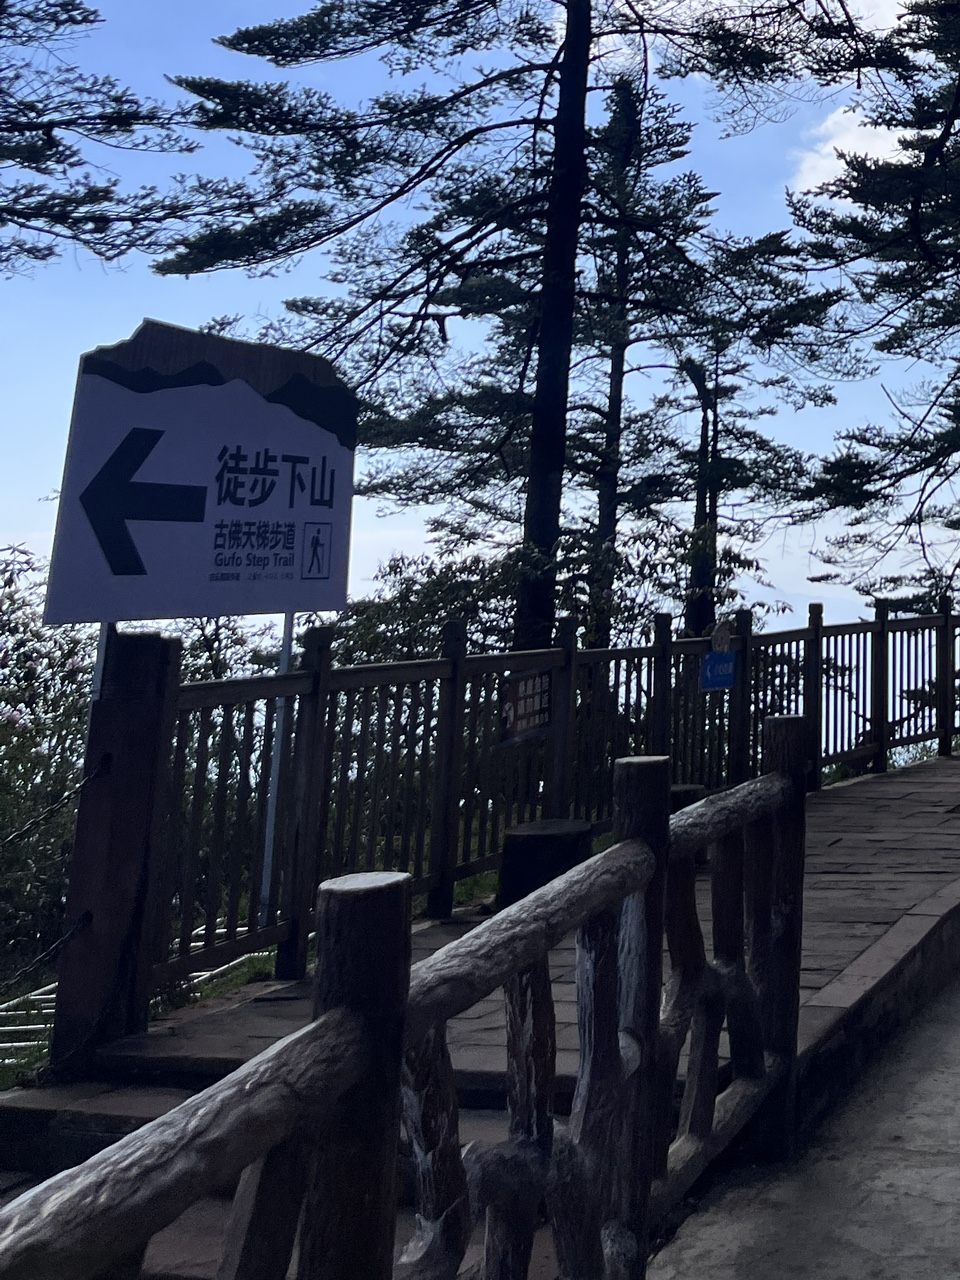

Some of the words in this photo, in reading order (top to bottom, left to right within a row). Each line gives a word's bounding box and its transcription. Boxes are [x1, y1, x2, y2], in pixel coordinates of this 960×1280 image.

[215, 444, 336, 509] 徒步下山
[213, 519, 295, 551] 古佛天梯步道
[214, 552, 242, 567] Gufo
[246, 552, 269, 570] Step
[273, 552, 295, 567] Trail
